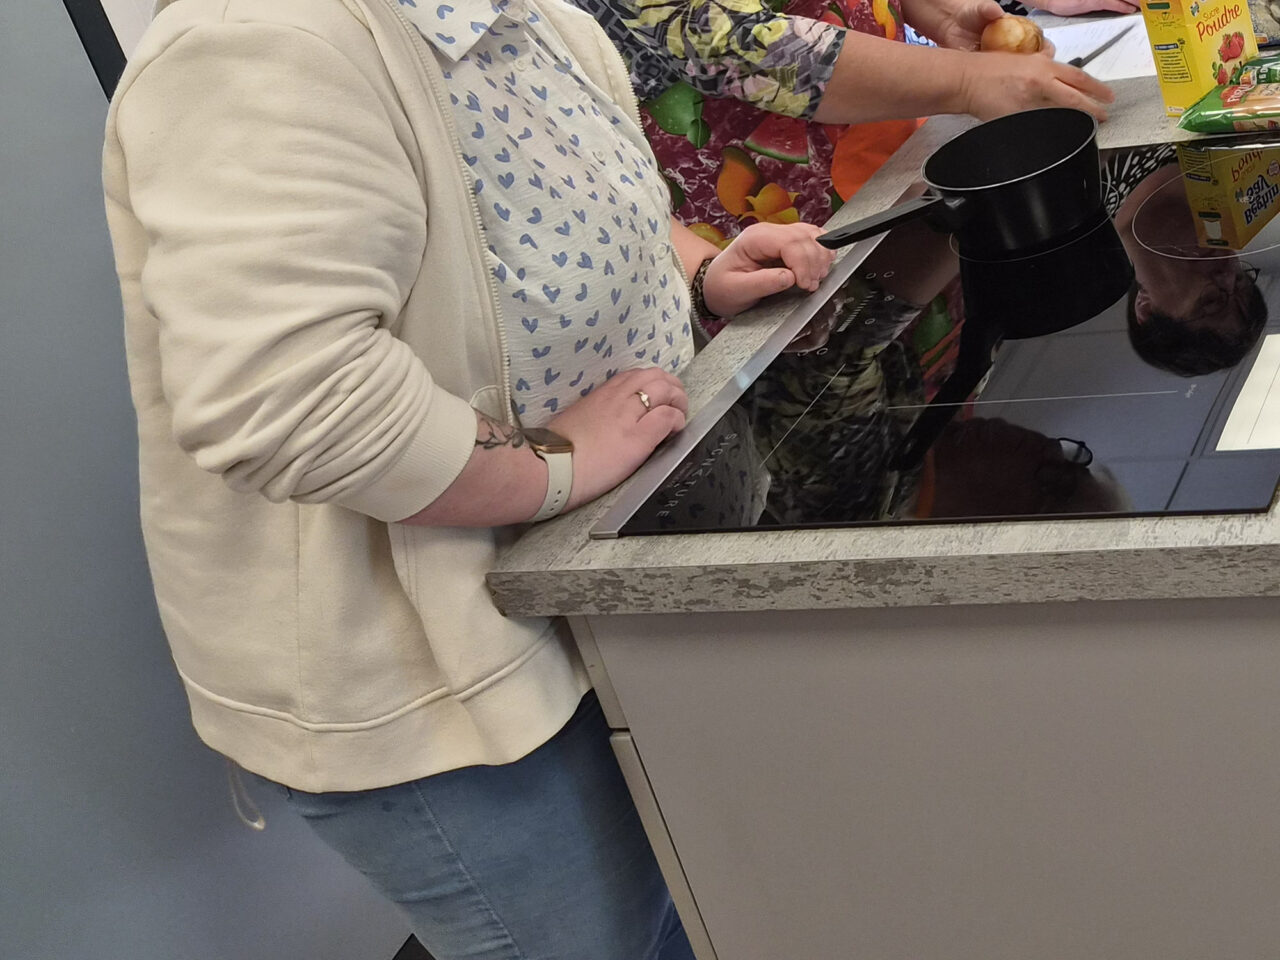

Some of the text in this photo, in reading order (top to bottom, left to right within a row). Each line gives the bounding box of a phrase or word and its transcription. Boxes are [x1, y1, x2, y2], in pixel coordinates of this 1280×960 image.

[1196, 4, 1243, 42] Poudre
[1203, 7, 1220, 22] Sucre
[656, 433, 737, 517] SIGNATURE
